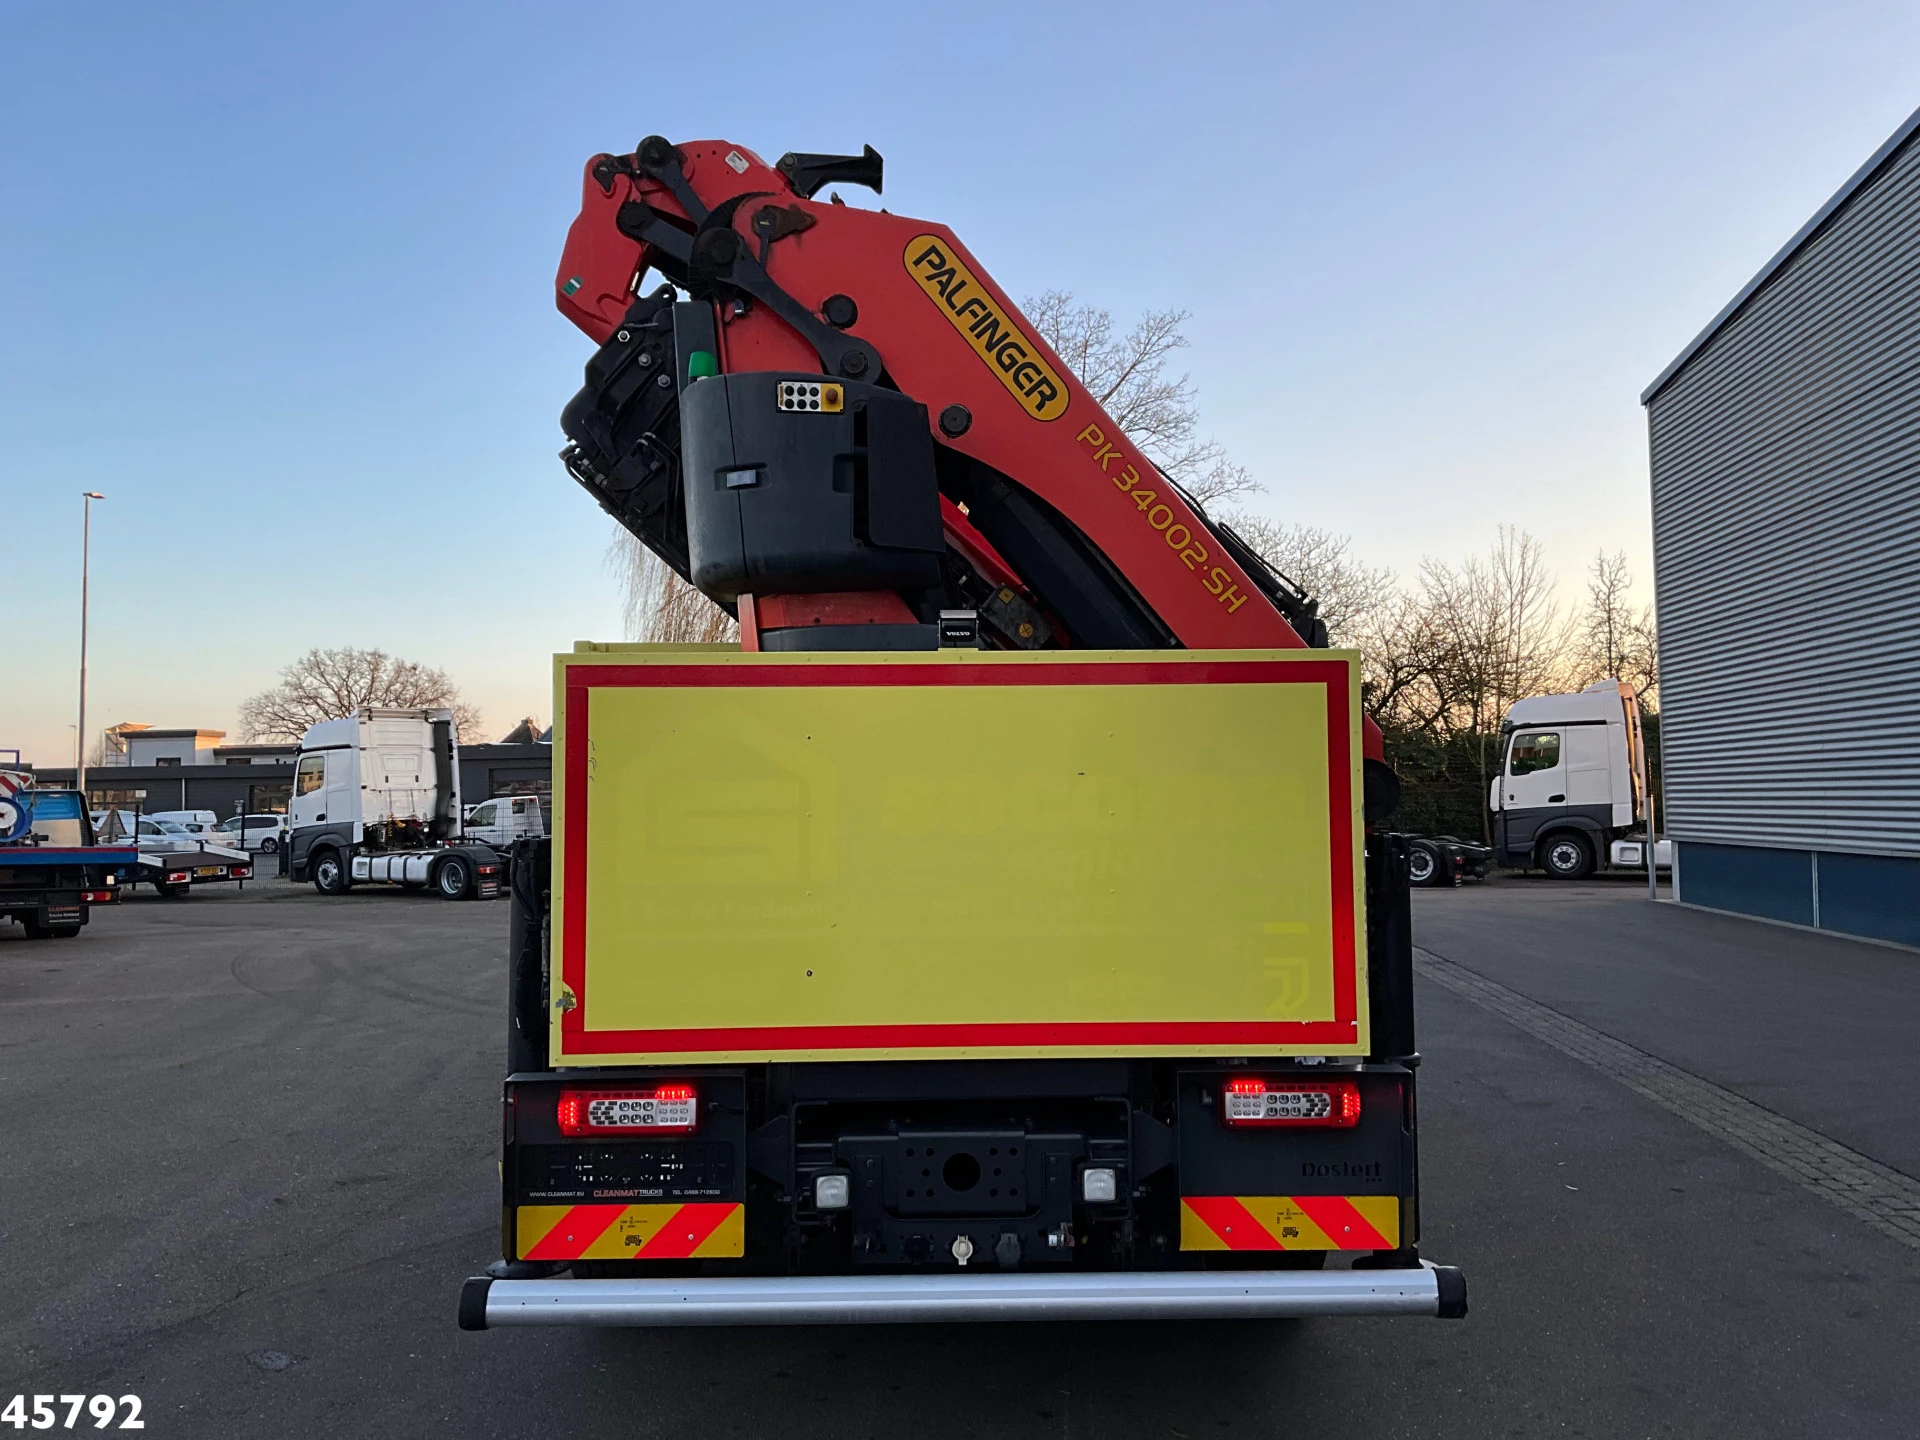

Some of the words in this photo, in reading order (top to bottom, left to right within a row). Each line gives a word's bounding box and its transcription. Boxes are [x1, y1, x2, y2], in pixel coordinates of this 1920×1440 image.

[912, 244, 1058, 412] PALFINGER
[1076, 423, 1123, 472] PK
[1302, 1161, 1382, 1177] Dostert
